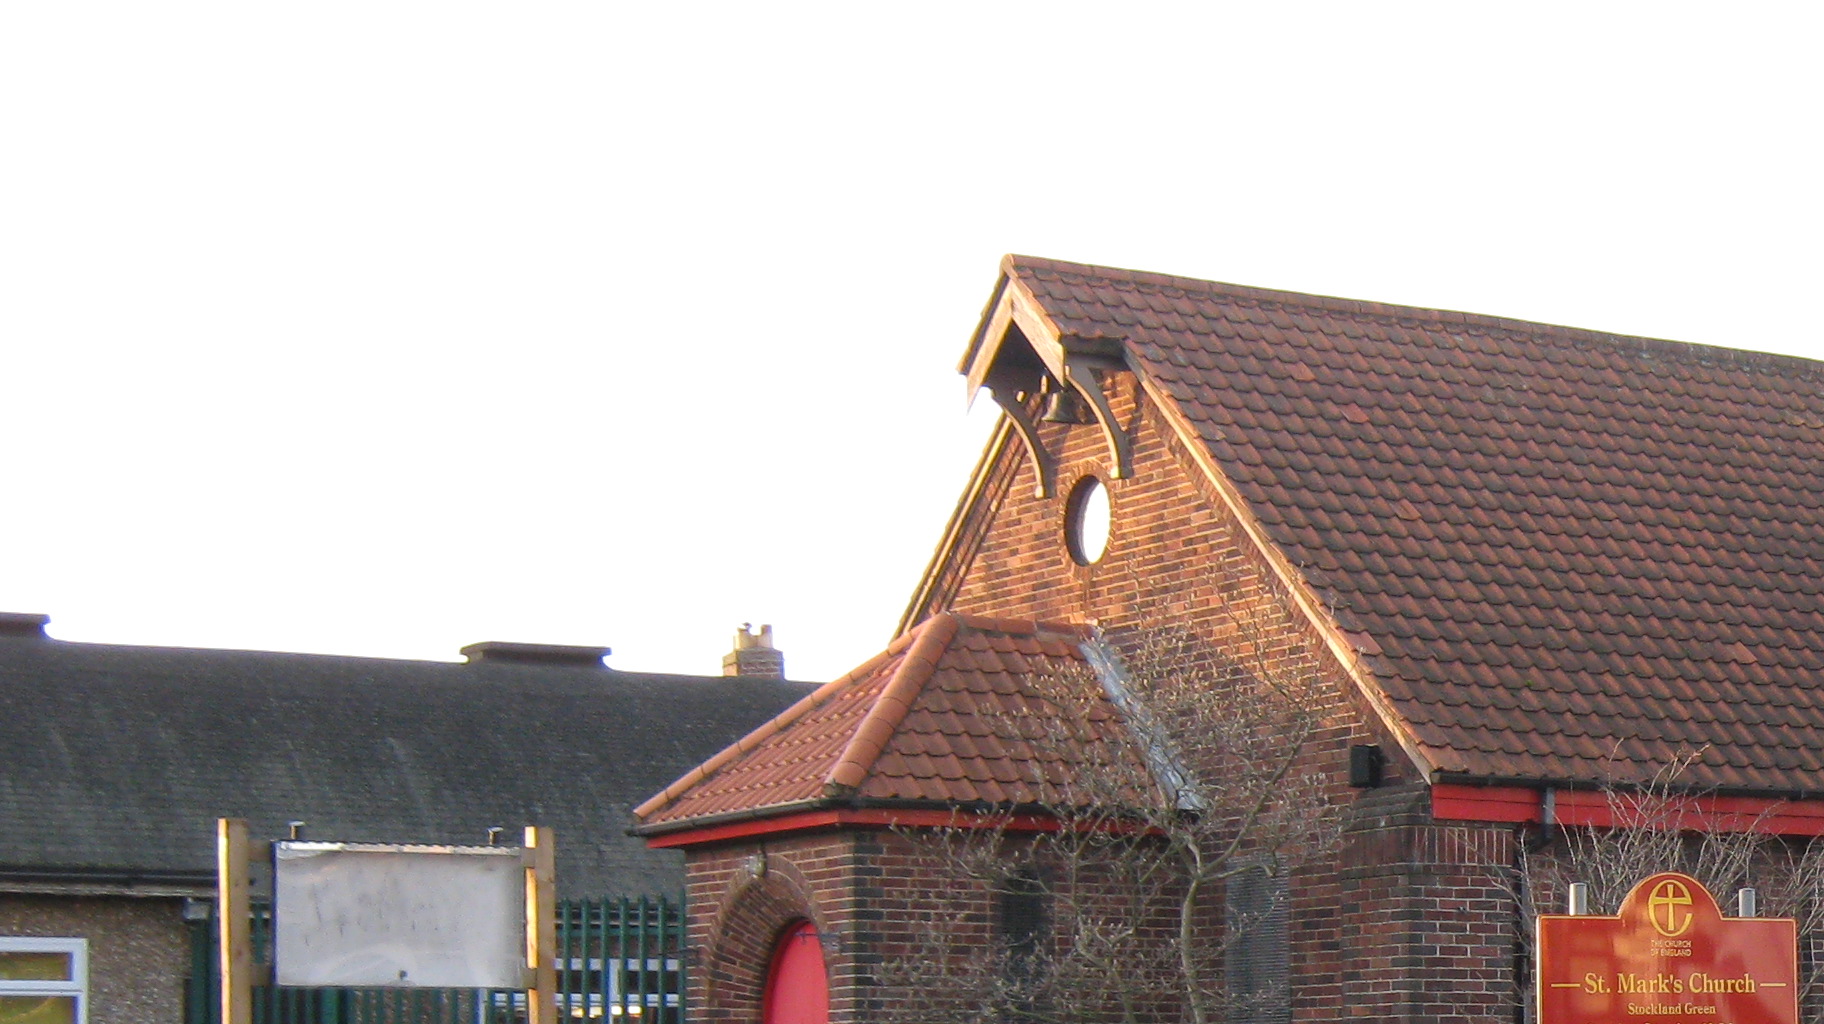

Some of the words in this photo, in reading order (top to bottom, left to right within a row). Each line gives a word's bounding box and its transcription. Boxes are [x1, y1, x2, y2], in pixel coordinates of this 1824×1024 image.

[1665, 939, 1692, 949] CHURCH
[1660, 948, 1692, 957] ENGLAND
[1584, 972, 1611, 994] St.
[1617, 972, 1684, 994] Mark's
[1688, 972, 1756, 993] Church
[1627, 1002, 1682, 1015] Stockland
[1684, 1002, 1716, 1015] Green
